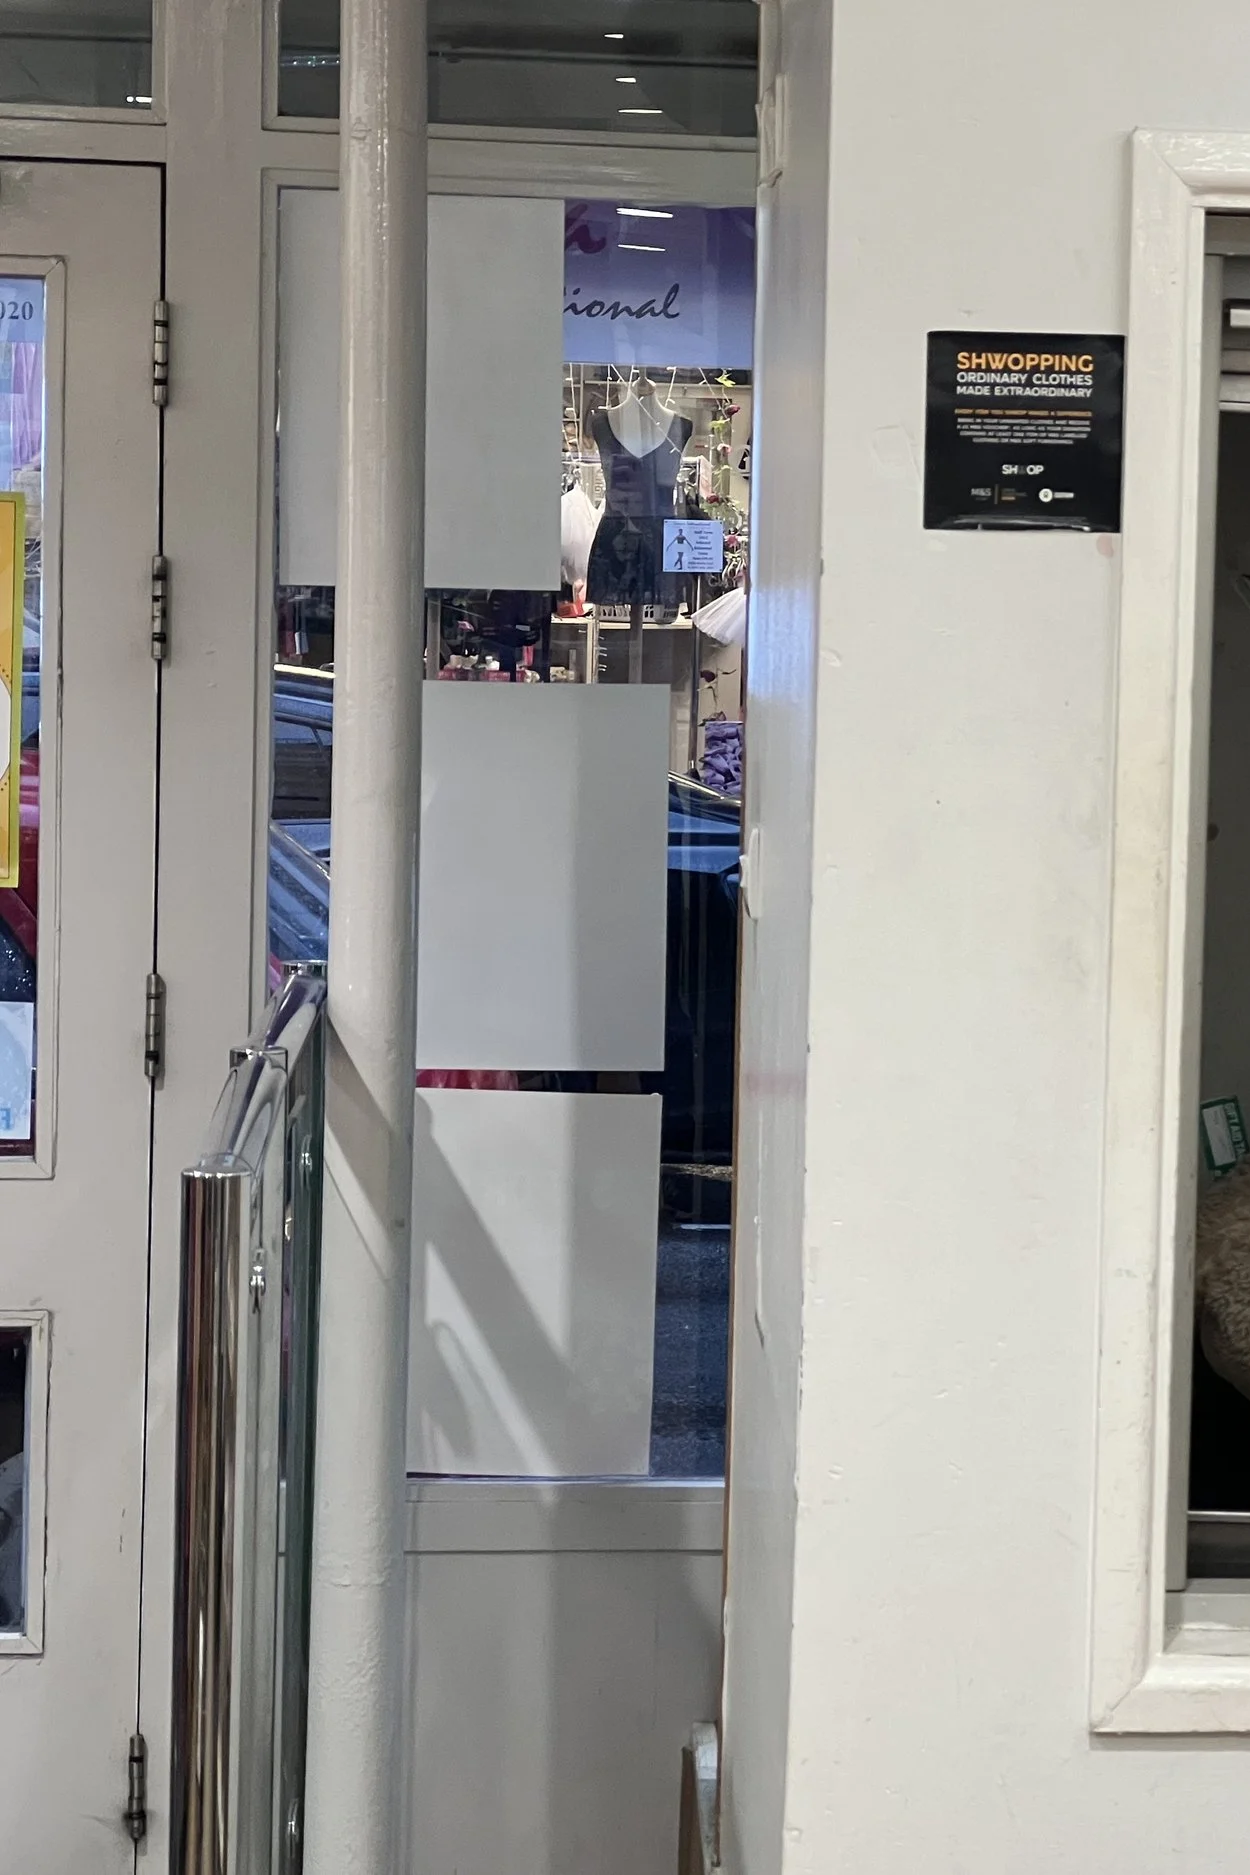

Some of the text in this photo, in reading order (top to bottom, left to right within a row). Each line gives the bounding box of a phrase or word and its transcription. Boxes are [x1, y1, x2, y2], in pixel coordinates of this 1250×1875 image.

[564, 283, 680, 319] ional
[957, 352, 1094, 372] SHWOPPING
[956, 372, 1093, 386] ORDINARY CLOTHES
[956, 386, 1092, 397] MADE EXTRAORDINARY
[1002, 464, 1044, 475] SHOP
